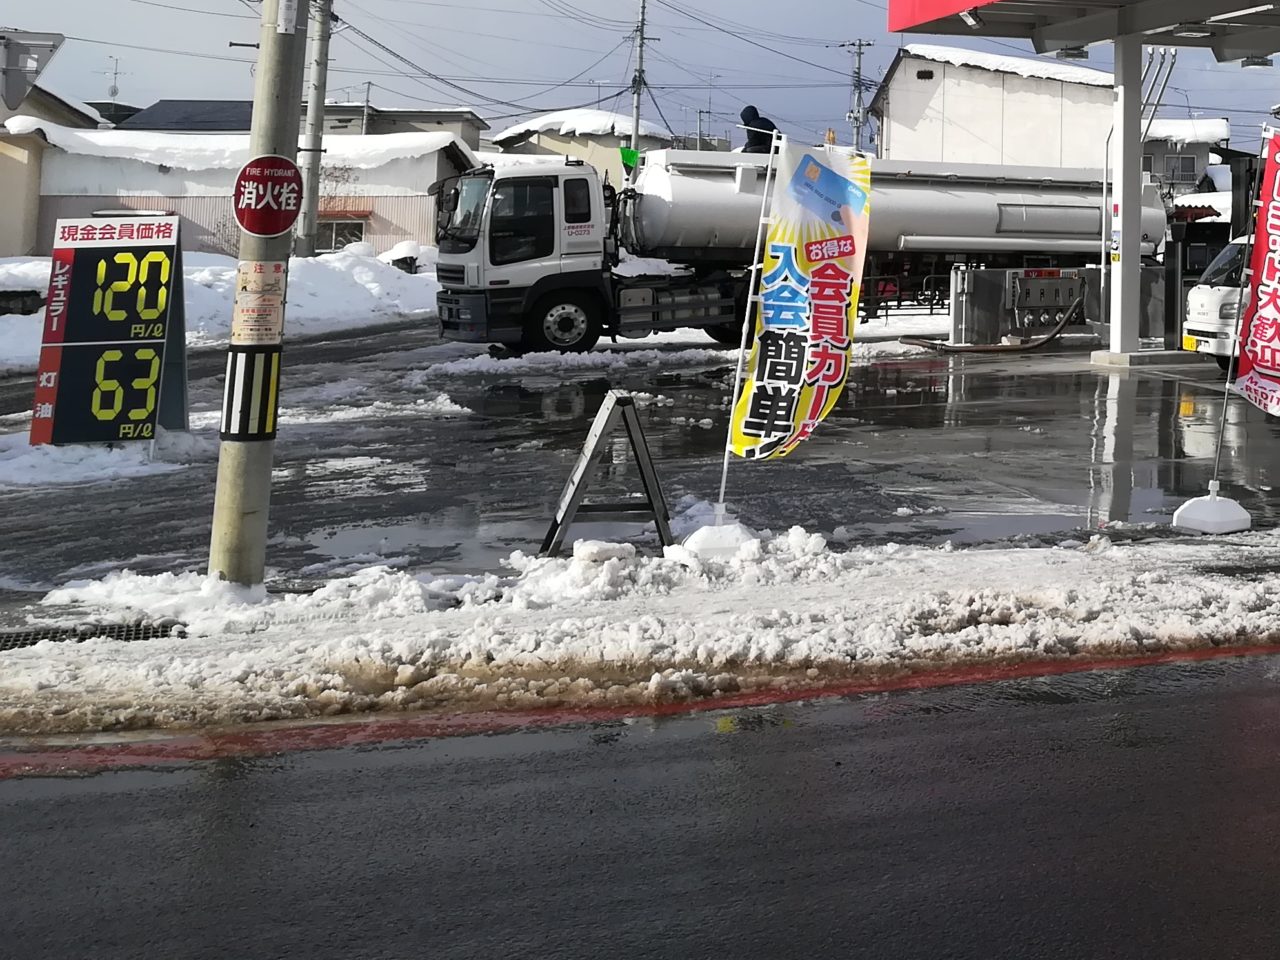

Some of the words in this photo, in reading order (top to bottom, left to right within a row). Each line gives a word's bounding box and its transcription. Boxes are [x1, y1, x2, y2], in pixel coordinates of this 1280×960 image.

[245, 167, 261, 176] FIRE
[264, 168, 296, 177] HYDRANT
[238, 180, 299, 211] 消火栓
[59, 222, 174, 242] 現金会員価格
[809, 239, 853, 260] お得な
[49, 260, 70, 332] レギュラー
[92, 251, 171, 321] 120
[34, 371, 58, 419] 灯油
[91, 348, 161, 421] 63
